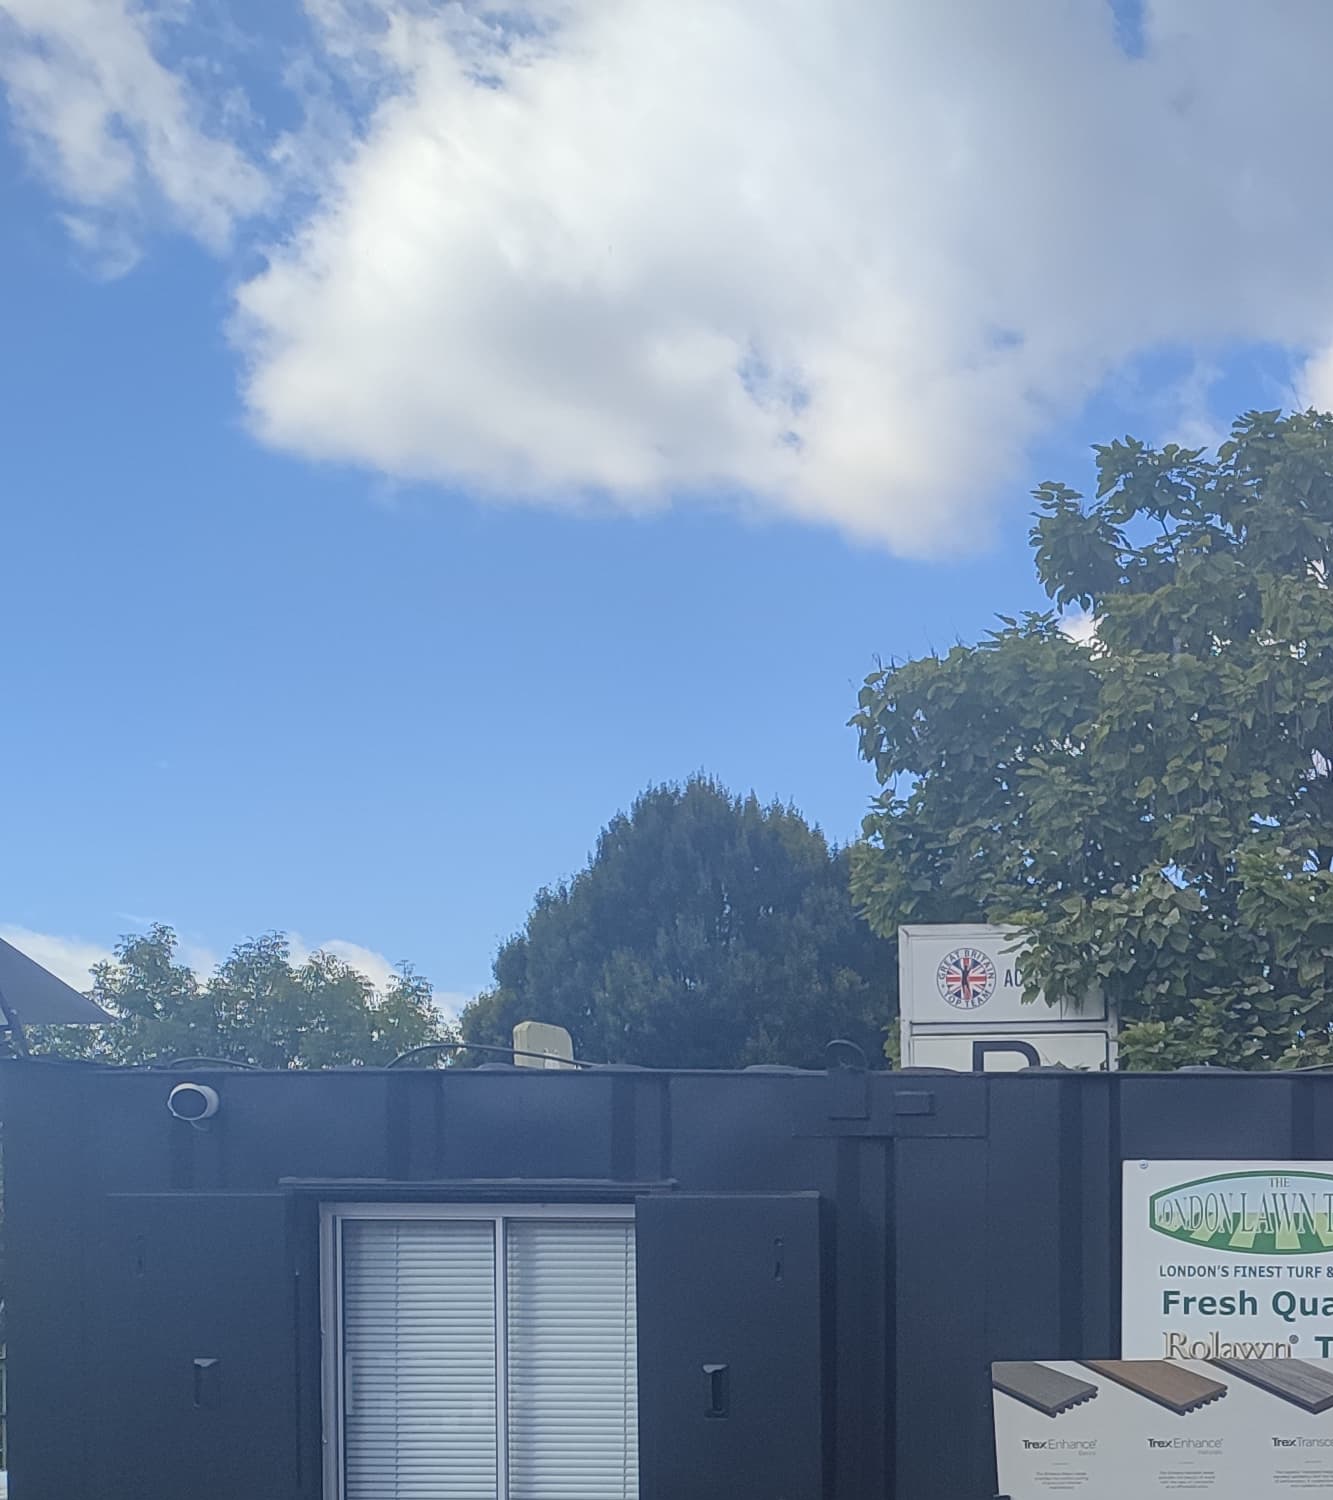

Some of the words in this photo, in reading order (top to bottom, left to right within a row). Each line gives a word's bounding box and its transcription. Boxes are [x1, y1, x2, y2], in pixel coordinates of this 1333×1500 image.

[938, 950, 961, 980] GREAT
[964, 950, 995, 979] BRITAIN
[1004, 969, 1022, 987] AC
[944, 992, 961, 1007] TOP
[966, 990, 992, 1008] TEAM
[1270, 1178, 1290, 1188] THE
[1158, 1193, 1233, 1232] LONDON
[1240, 1192, 1316, 1234] LAWN
[1159, 1265, 1229, 1277] LONDON'S
[1234, 1265, 1283, 1278] FINEST
[1288, 1266, 1321, 1278] TURF
[1163, 1290, 1257, 1315] Fresh
[1022, 1439, 1047, 1449] Trex
[1147, 1438, 1172, 1448] Trex
[1272, 1437, 1296, 1447] Trex
